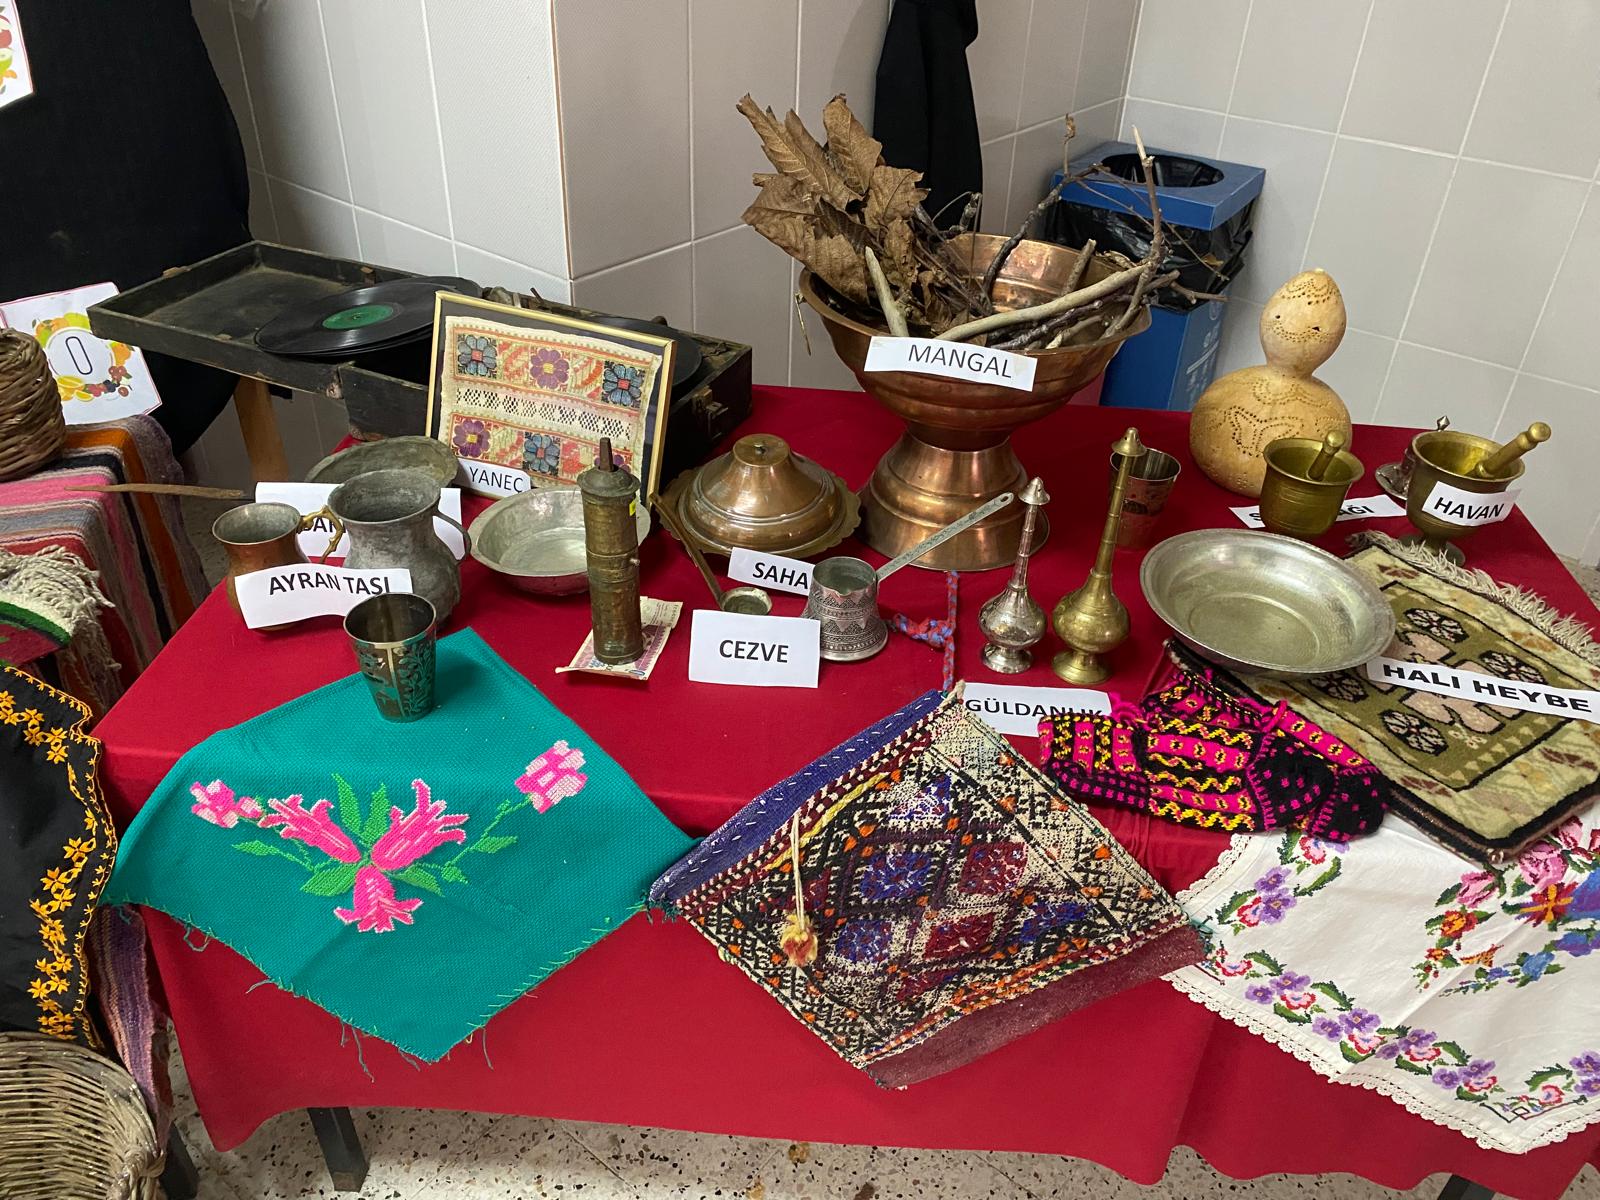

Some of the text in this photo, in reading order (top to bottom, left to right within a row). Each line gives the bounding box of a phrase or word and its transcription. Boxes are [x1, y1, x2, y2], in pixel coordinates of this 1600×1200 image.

[908, 344, 1012, 379] MANGAL
[1434, 497, 1504, 520] HAVAN
[269, 572, 390, 595] AYRAN TASI
[719, 639, 789, 664] CEZVE
[1383, 664, 1592, 713] HALI HEYBE
